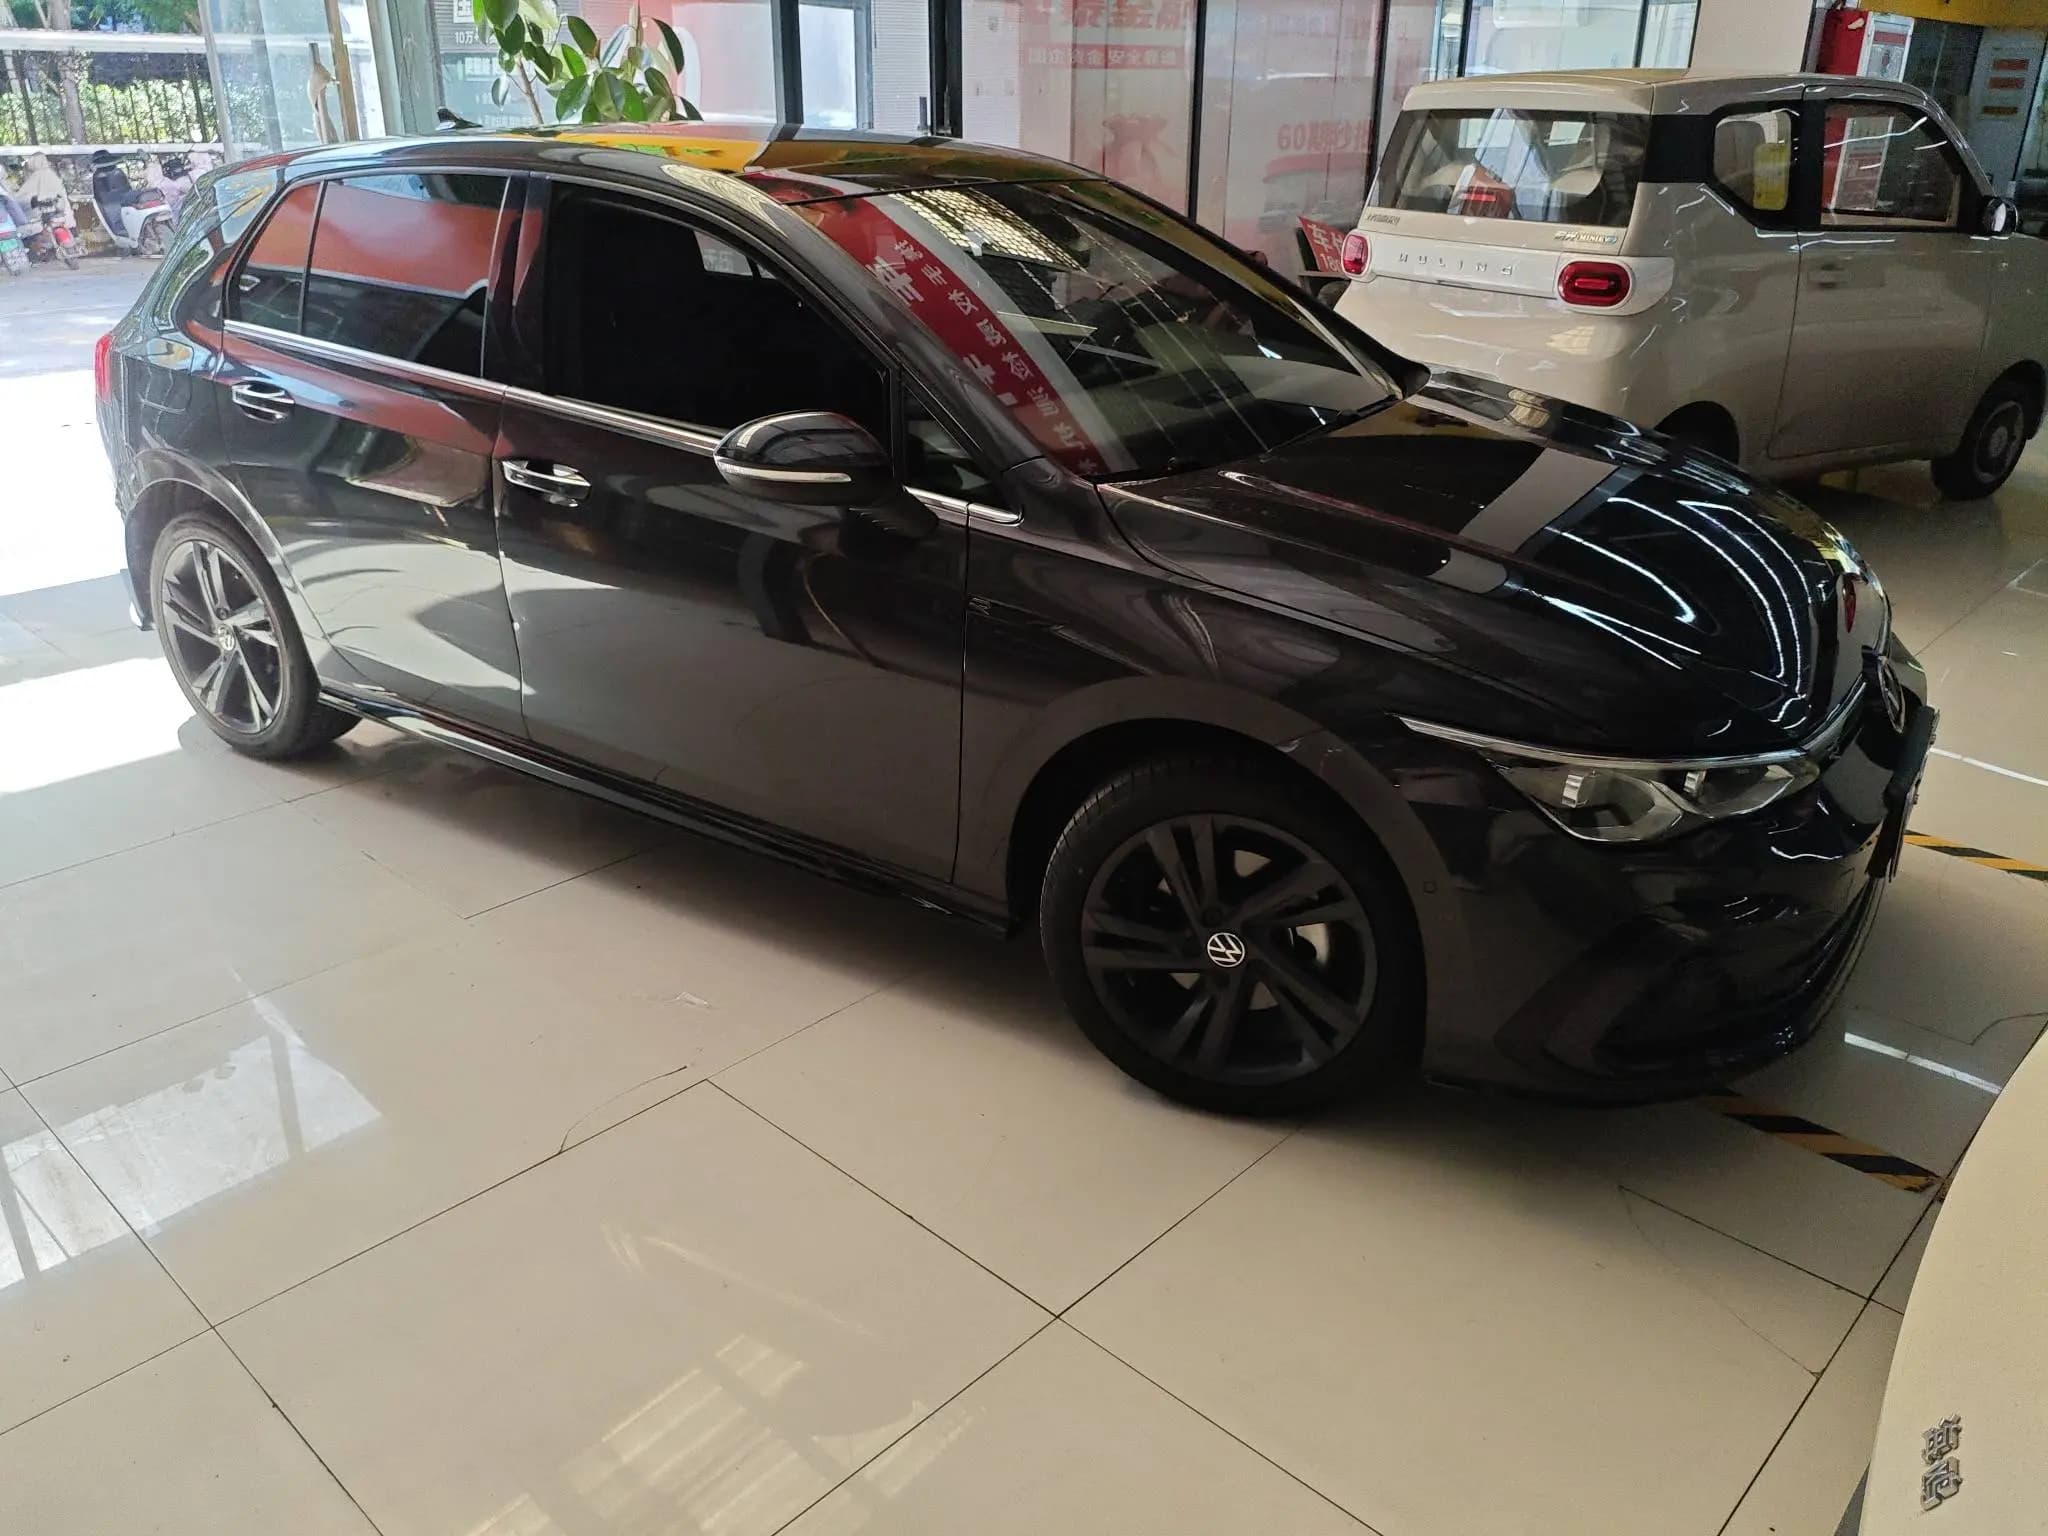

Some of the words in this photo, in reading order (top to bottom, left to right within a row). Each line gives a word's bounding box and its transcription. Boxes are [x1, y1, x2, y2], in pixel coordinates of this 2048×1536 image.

[1398, 251, 1514, 275] WULING
[1207, 932, 1246, 968] VW
[1919, 1413, 1964, 1512] 海鸥
